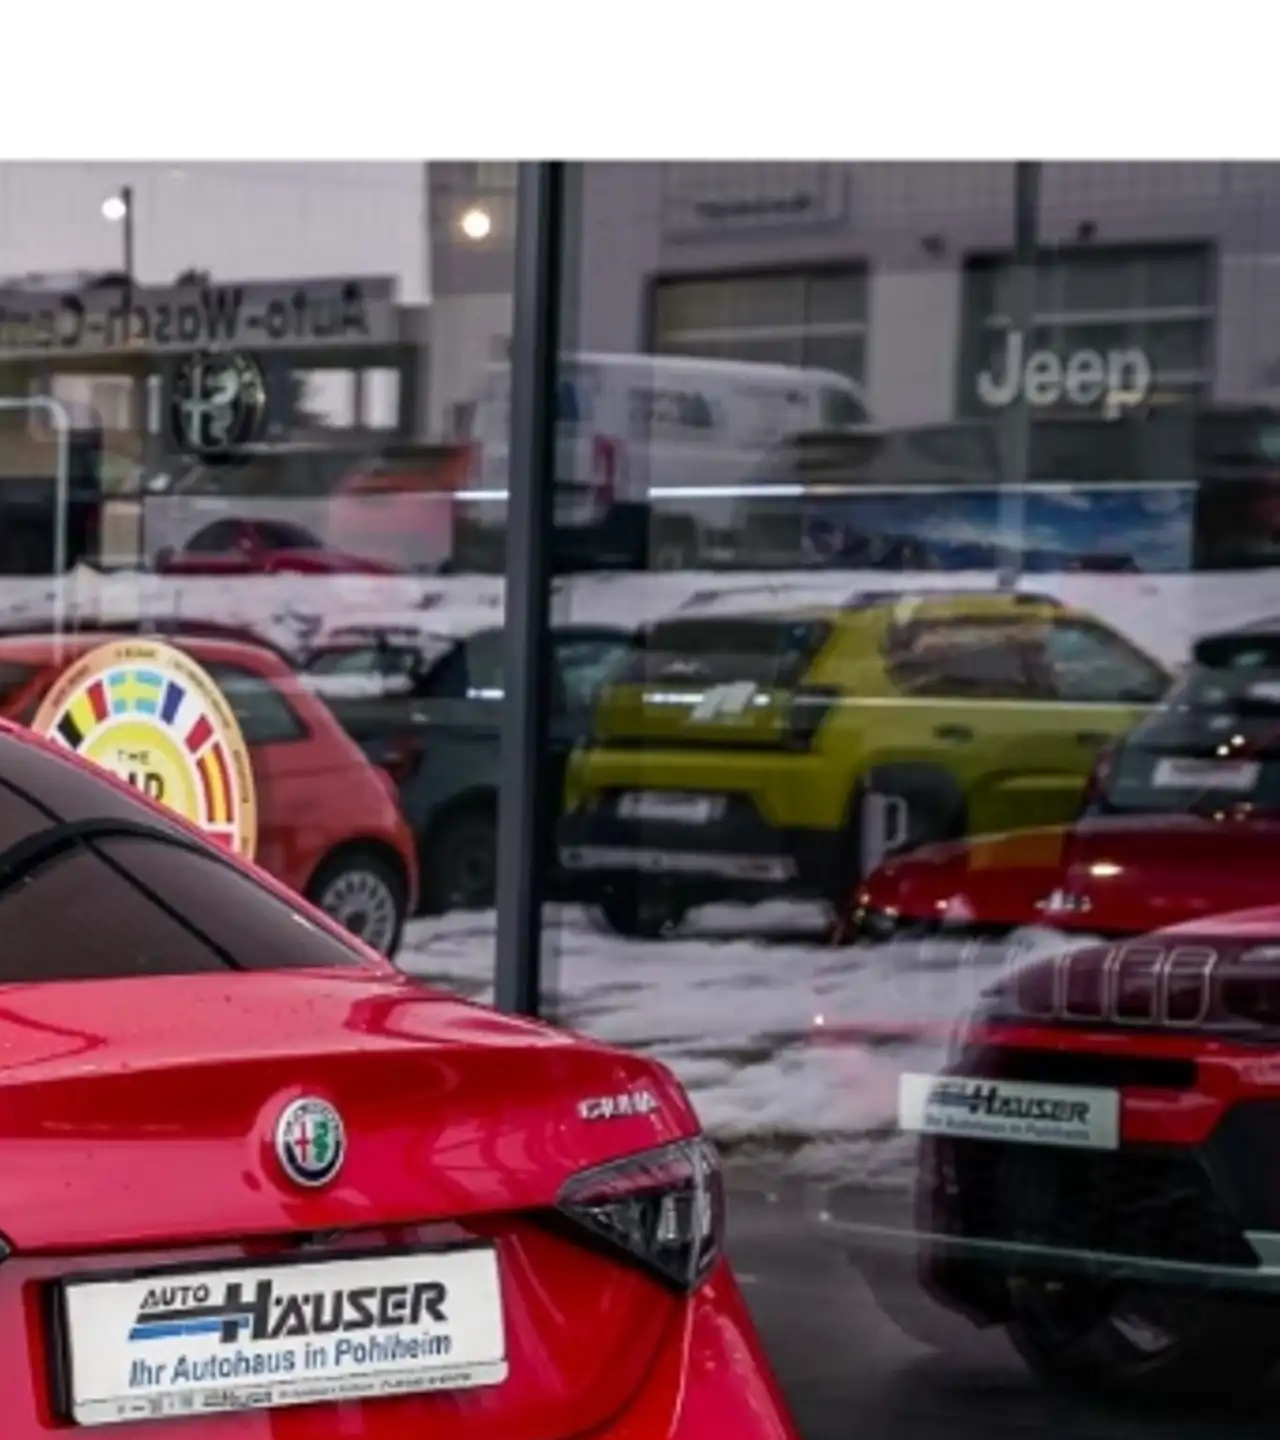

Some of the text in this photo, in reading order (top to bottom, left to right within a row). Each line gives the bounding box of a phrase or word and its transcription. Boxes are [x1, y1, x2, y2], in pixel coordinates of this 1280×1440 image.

[976, 331, 1151, 421] Jeep
[140, 1279, 448, 1344] AUTO HÄUSER
[128, 1331, 453, 1388] Ihr Autohaus in Pohlheim
